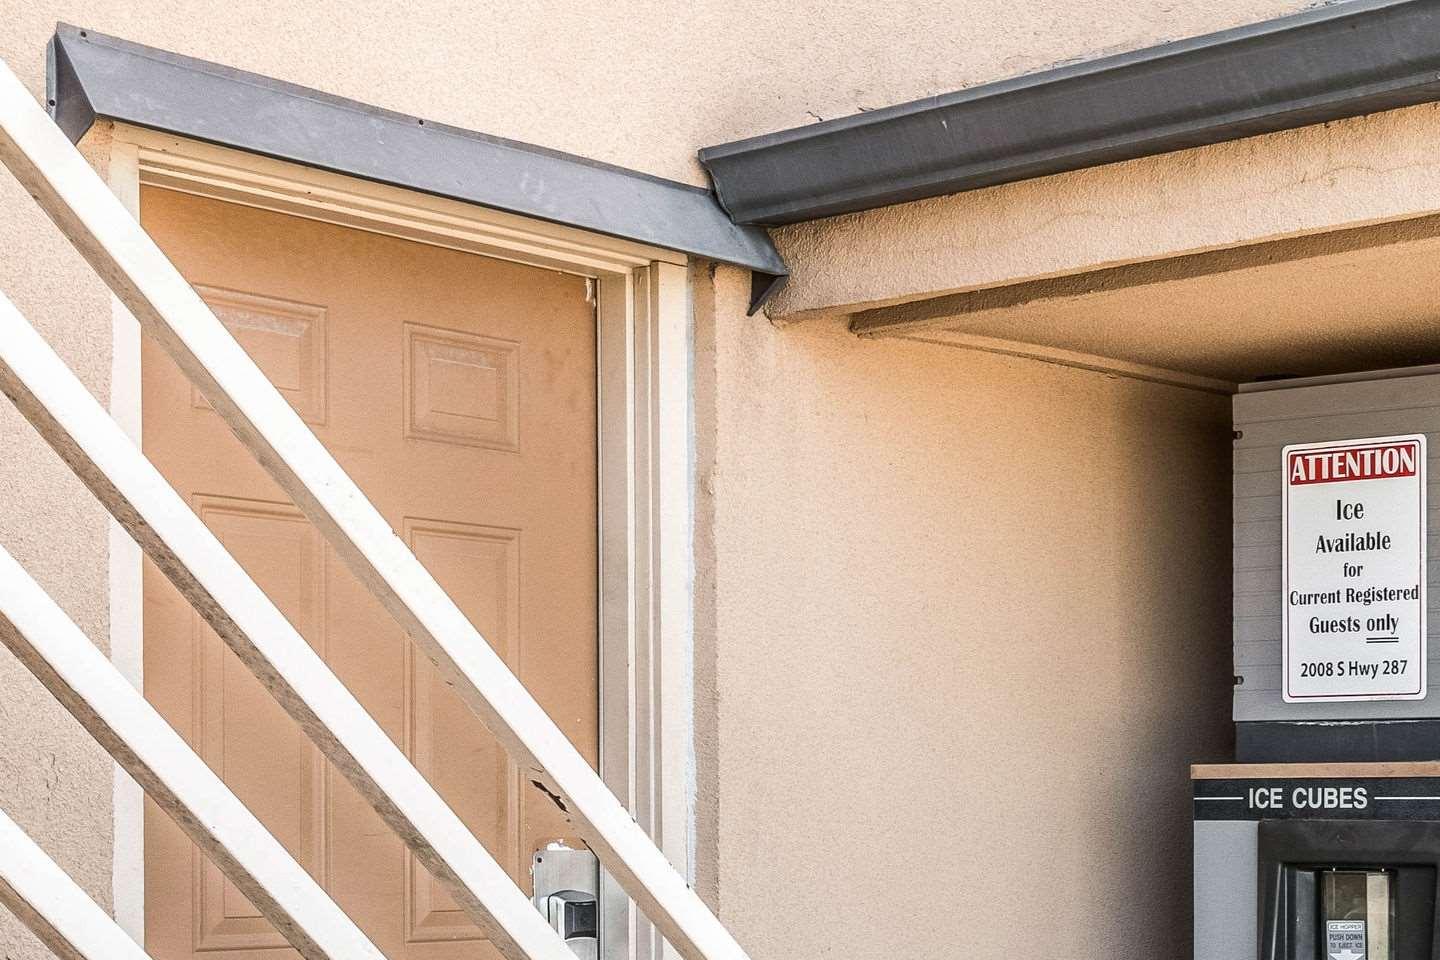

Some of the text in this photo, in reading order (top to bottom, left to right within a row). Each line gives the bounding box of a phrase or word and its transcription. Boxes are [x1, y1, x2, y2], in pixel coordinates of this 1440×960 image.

[1291, 446, 1415, 481] ATTENTION
[1336, 499, 1364, 520] Ice
[1315, 531, 1391, 554] Available
[1343, 562, 1364, 577] for
[1290, 584, 1419, 606] Current Registered
[1309, 613, 1399, 635] Guests only
[1300, 660, 1408, 680] 2008 S Hwy 287
[1249, 787, 1368, 809] ICE CUBES
[1329, 933, 1363, 941] PUSH DOWN
